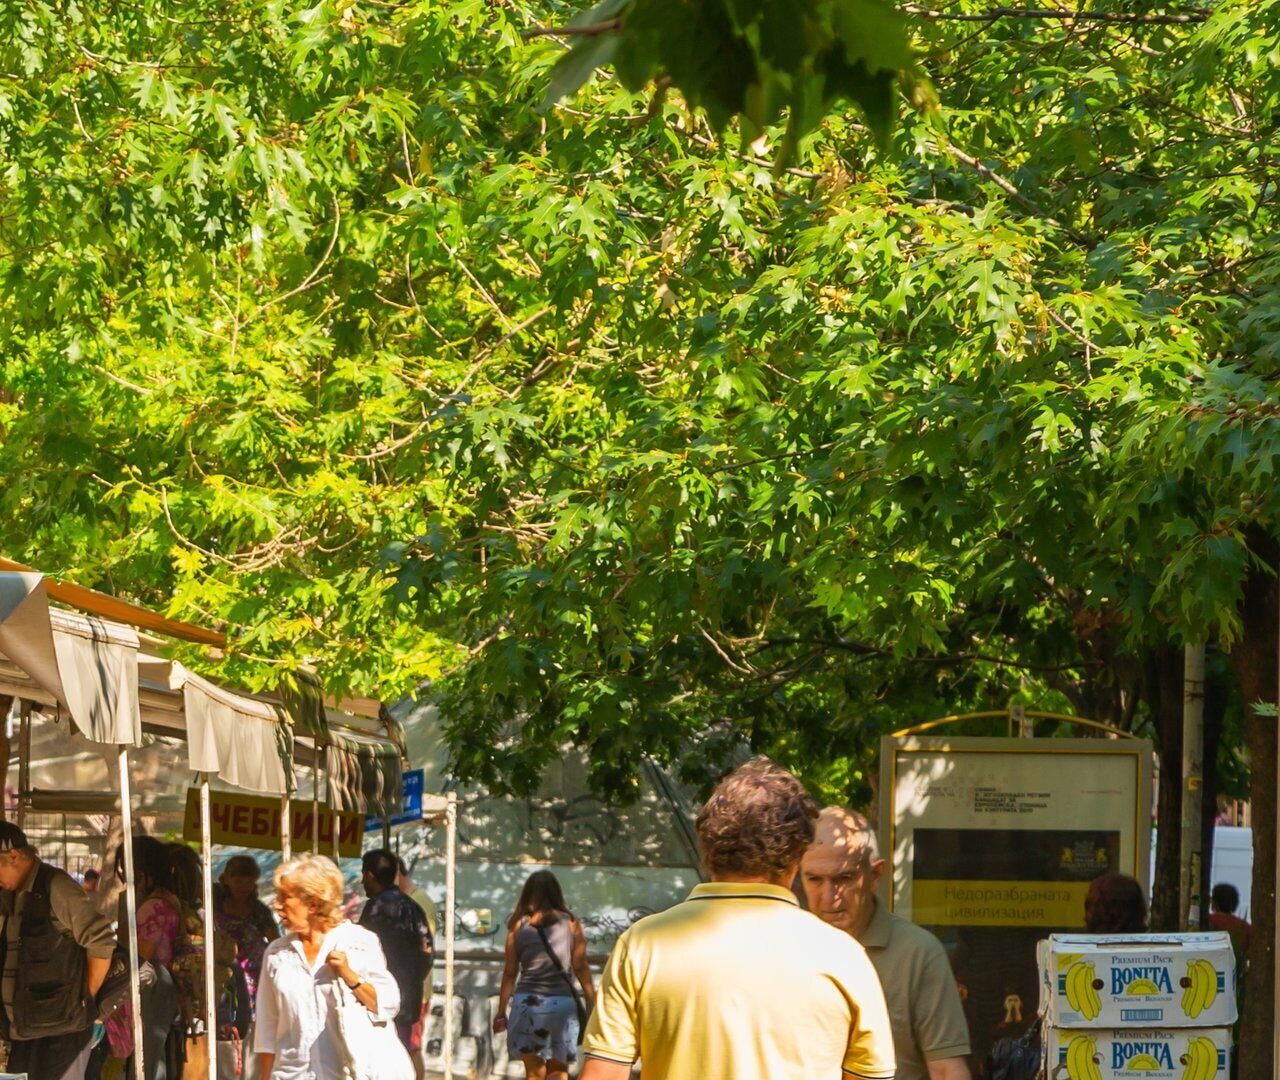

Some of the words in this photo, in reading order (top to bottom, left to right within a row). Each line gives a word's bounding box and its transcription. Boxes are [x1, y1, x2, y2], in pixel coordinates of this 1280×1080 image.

[944, 885, 1072, 905] Недоразбраната
[944, 905, 1045, 920] цивилизация
[1111, 955, 1151, 964] PREMIUM
[1152, 955, 1173, 964] PACK
[1110, 967, 1175, 995] BONITA
[1113, 1030, 1152, 1039] PREMIUM
[1154, 1030, 1175, 1039] PACK
[1111, 1042, 1176, 1069] BONITA
